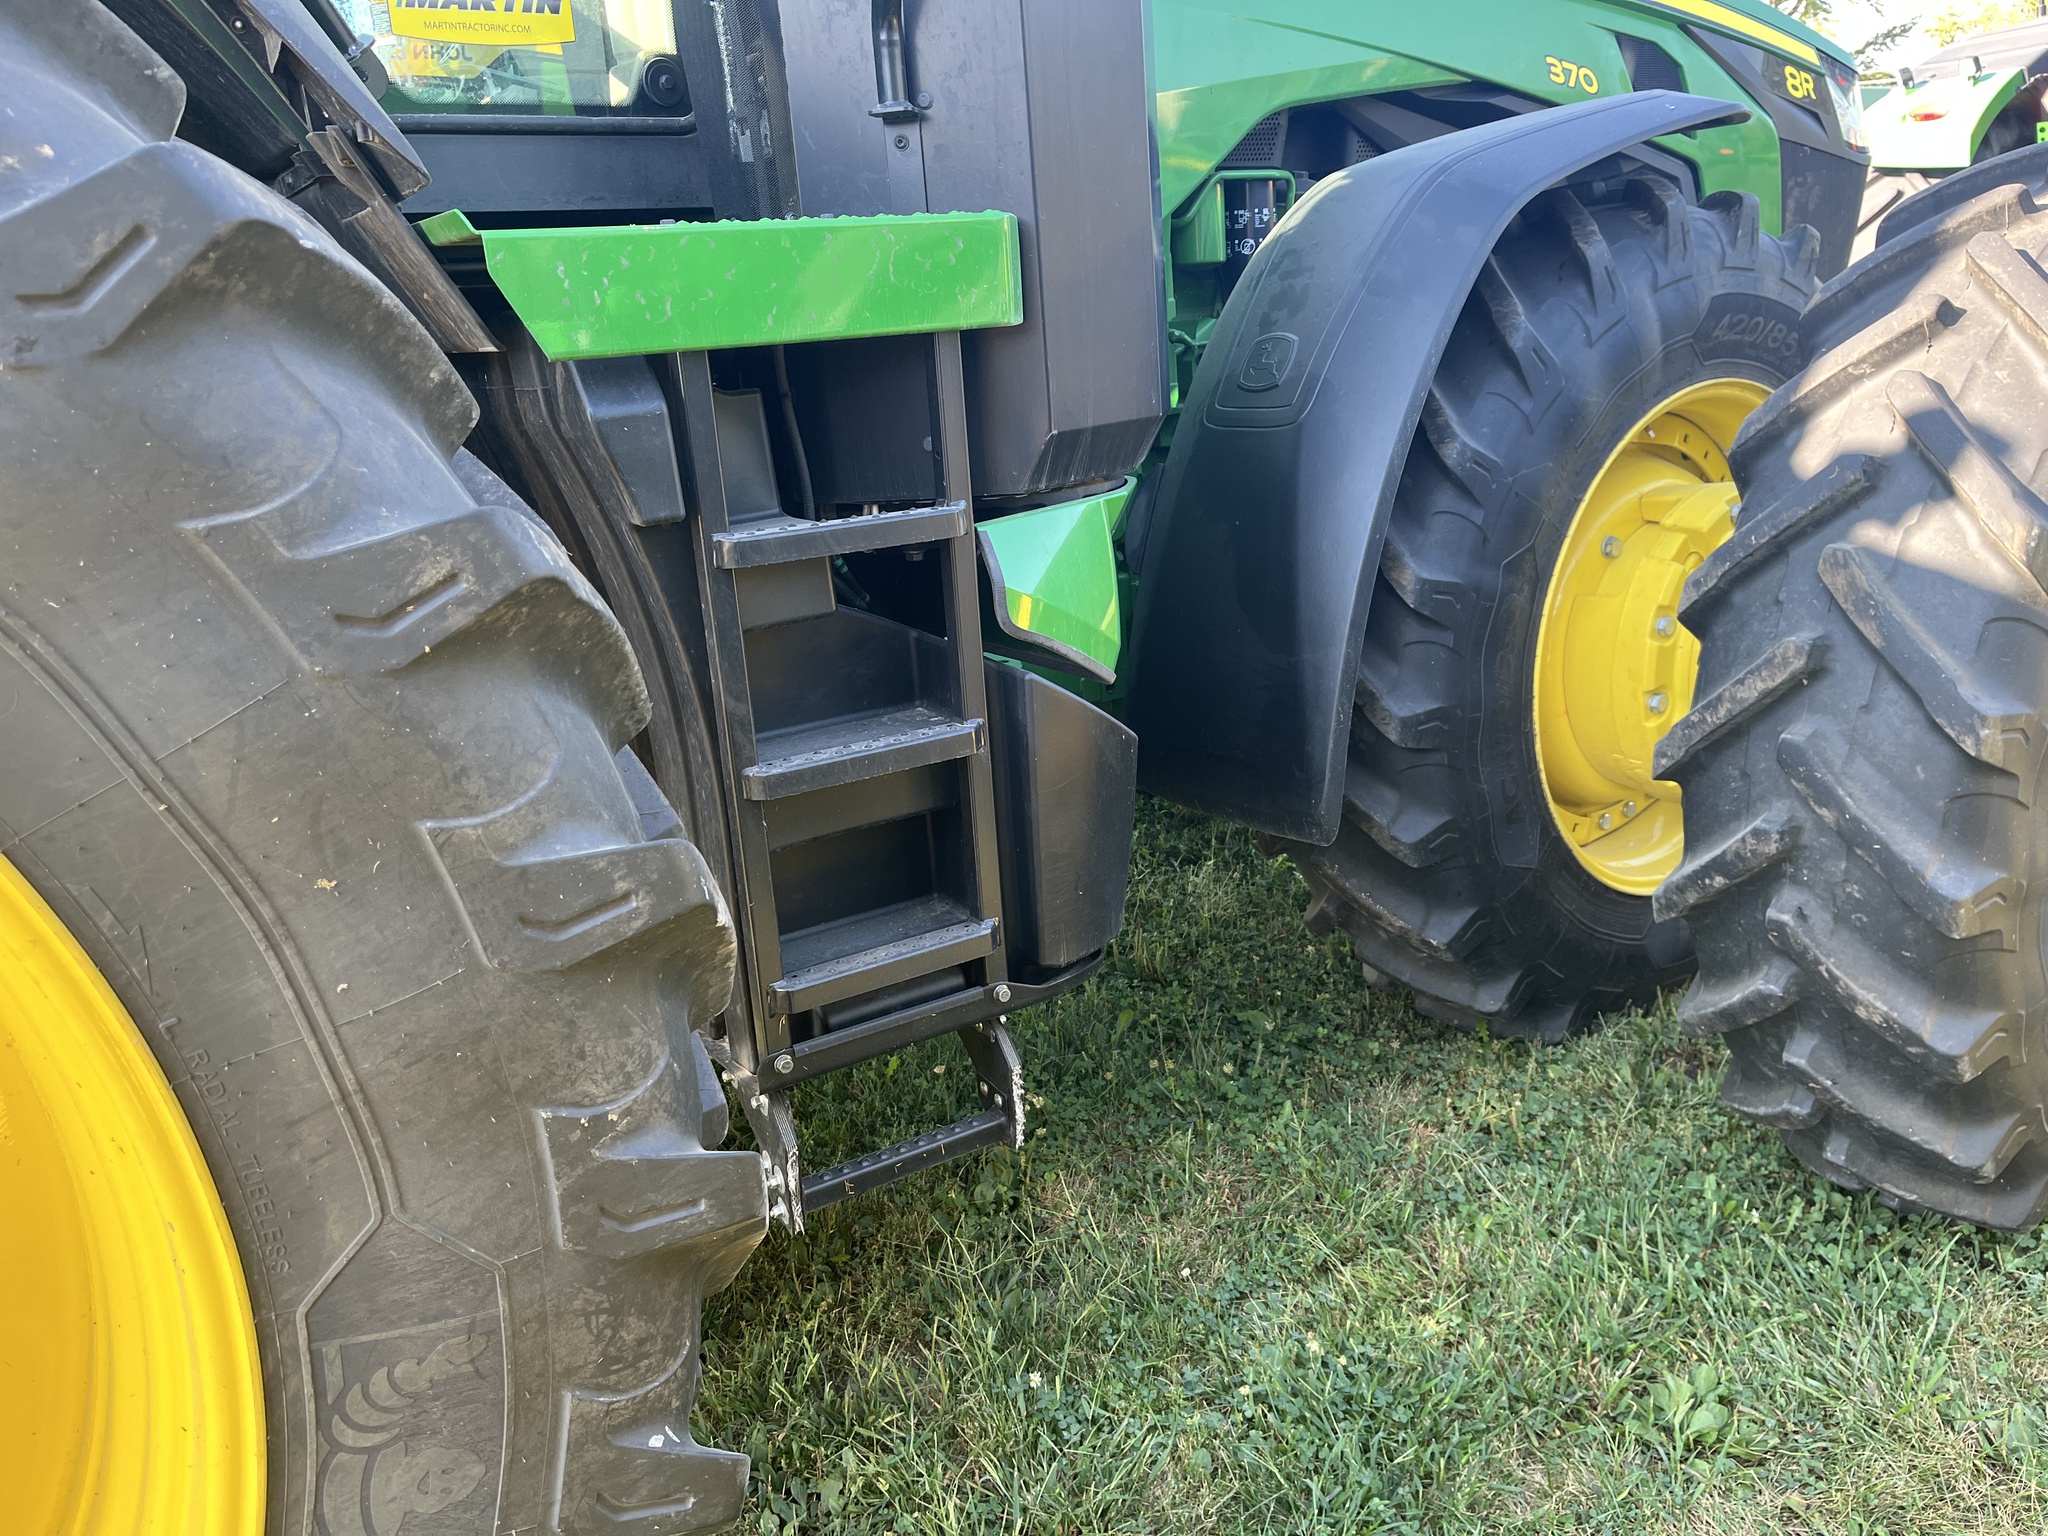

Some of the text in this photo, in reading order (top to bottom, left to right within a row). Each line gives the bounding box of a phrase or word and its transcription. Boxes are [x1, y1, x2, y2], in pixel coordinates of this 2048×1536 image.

[423, 21, 532, 34] MARTINTRACTORINC.COM
[1545, 55, 1599, 95] 370
[1784, 65, 1817, 100] 8R
[1712, 313, 1799, 356] 420/85
[185, 1048, 240, 1137] RADIAL
[238, 1153, 291, 1275] TUBELESS
